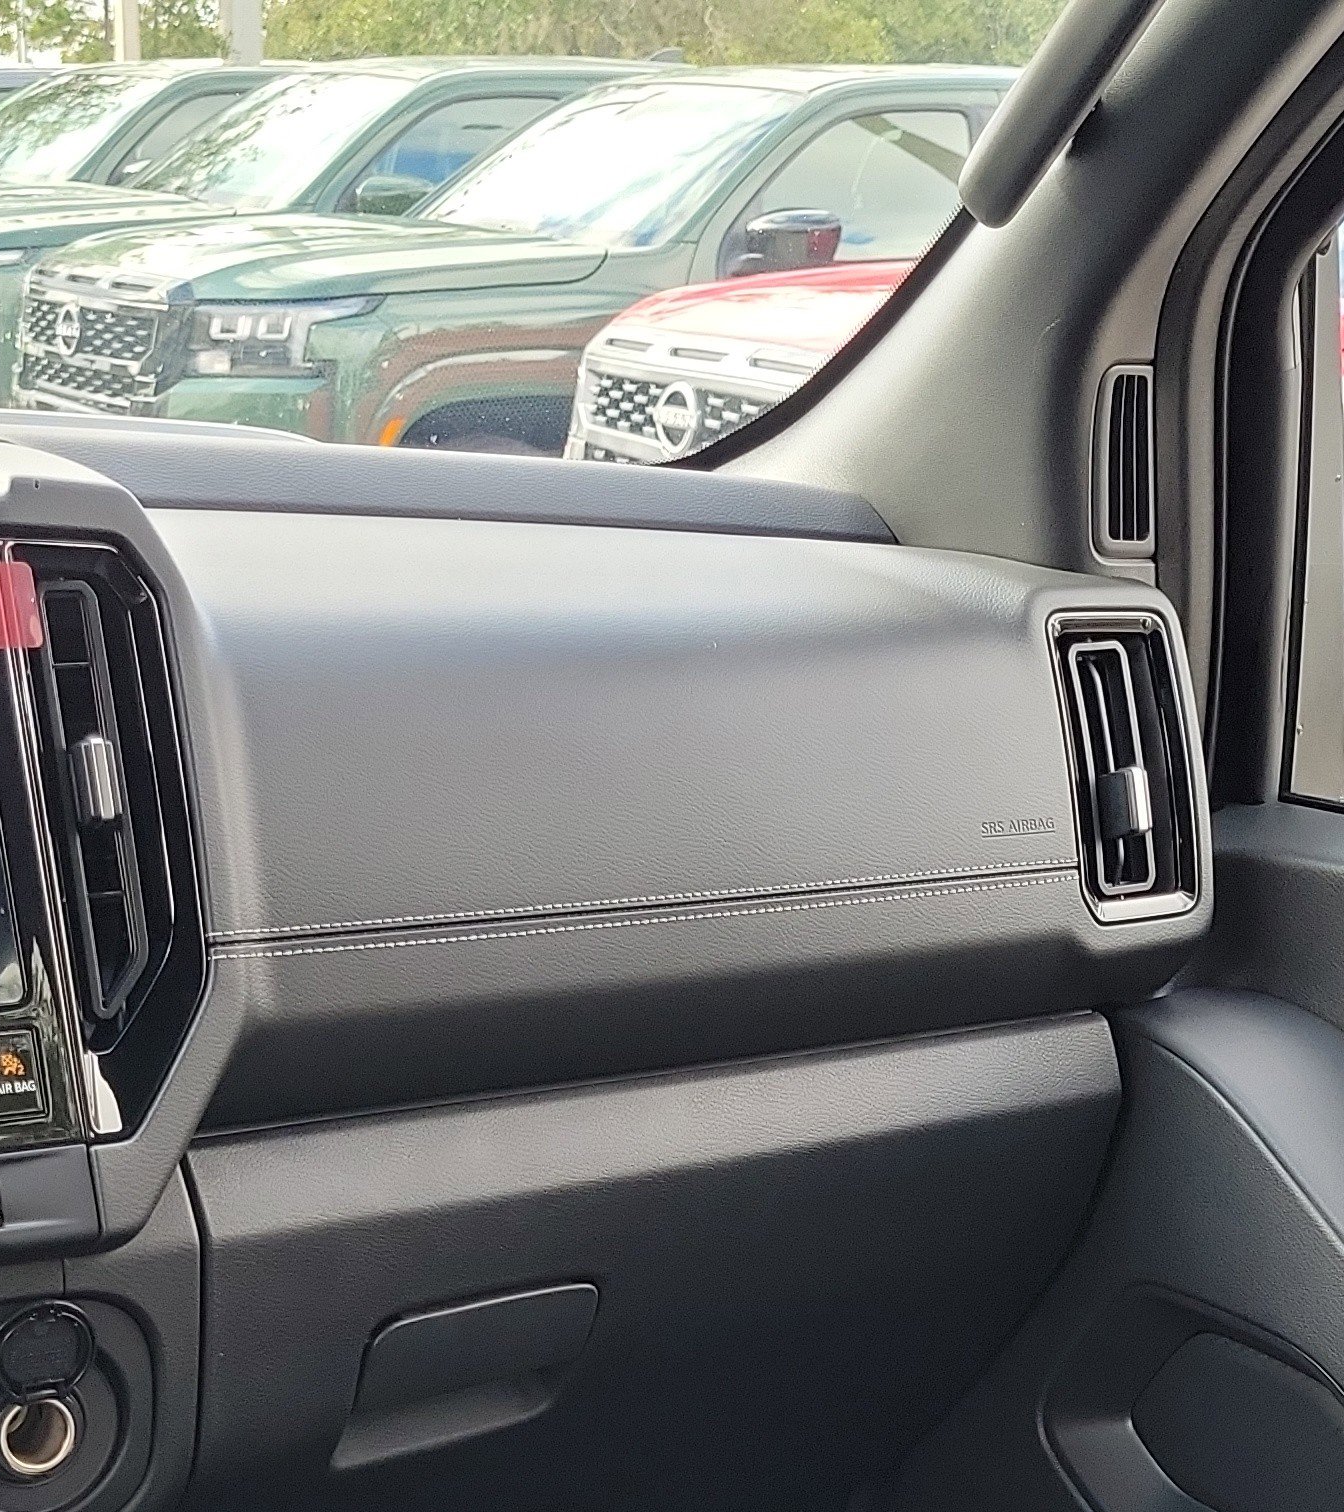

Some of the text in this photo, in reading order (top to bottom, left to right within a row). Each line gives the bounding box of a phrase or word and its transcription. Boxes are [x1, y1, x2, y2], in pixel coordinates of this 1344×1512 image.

[981, 817, 1055, 835] SRS AIRBAG
[15, 1080, 37, 1093] BAG
